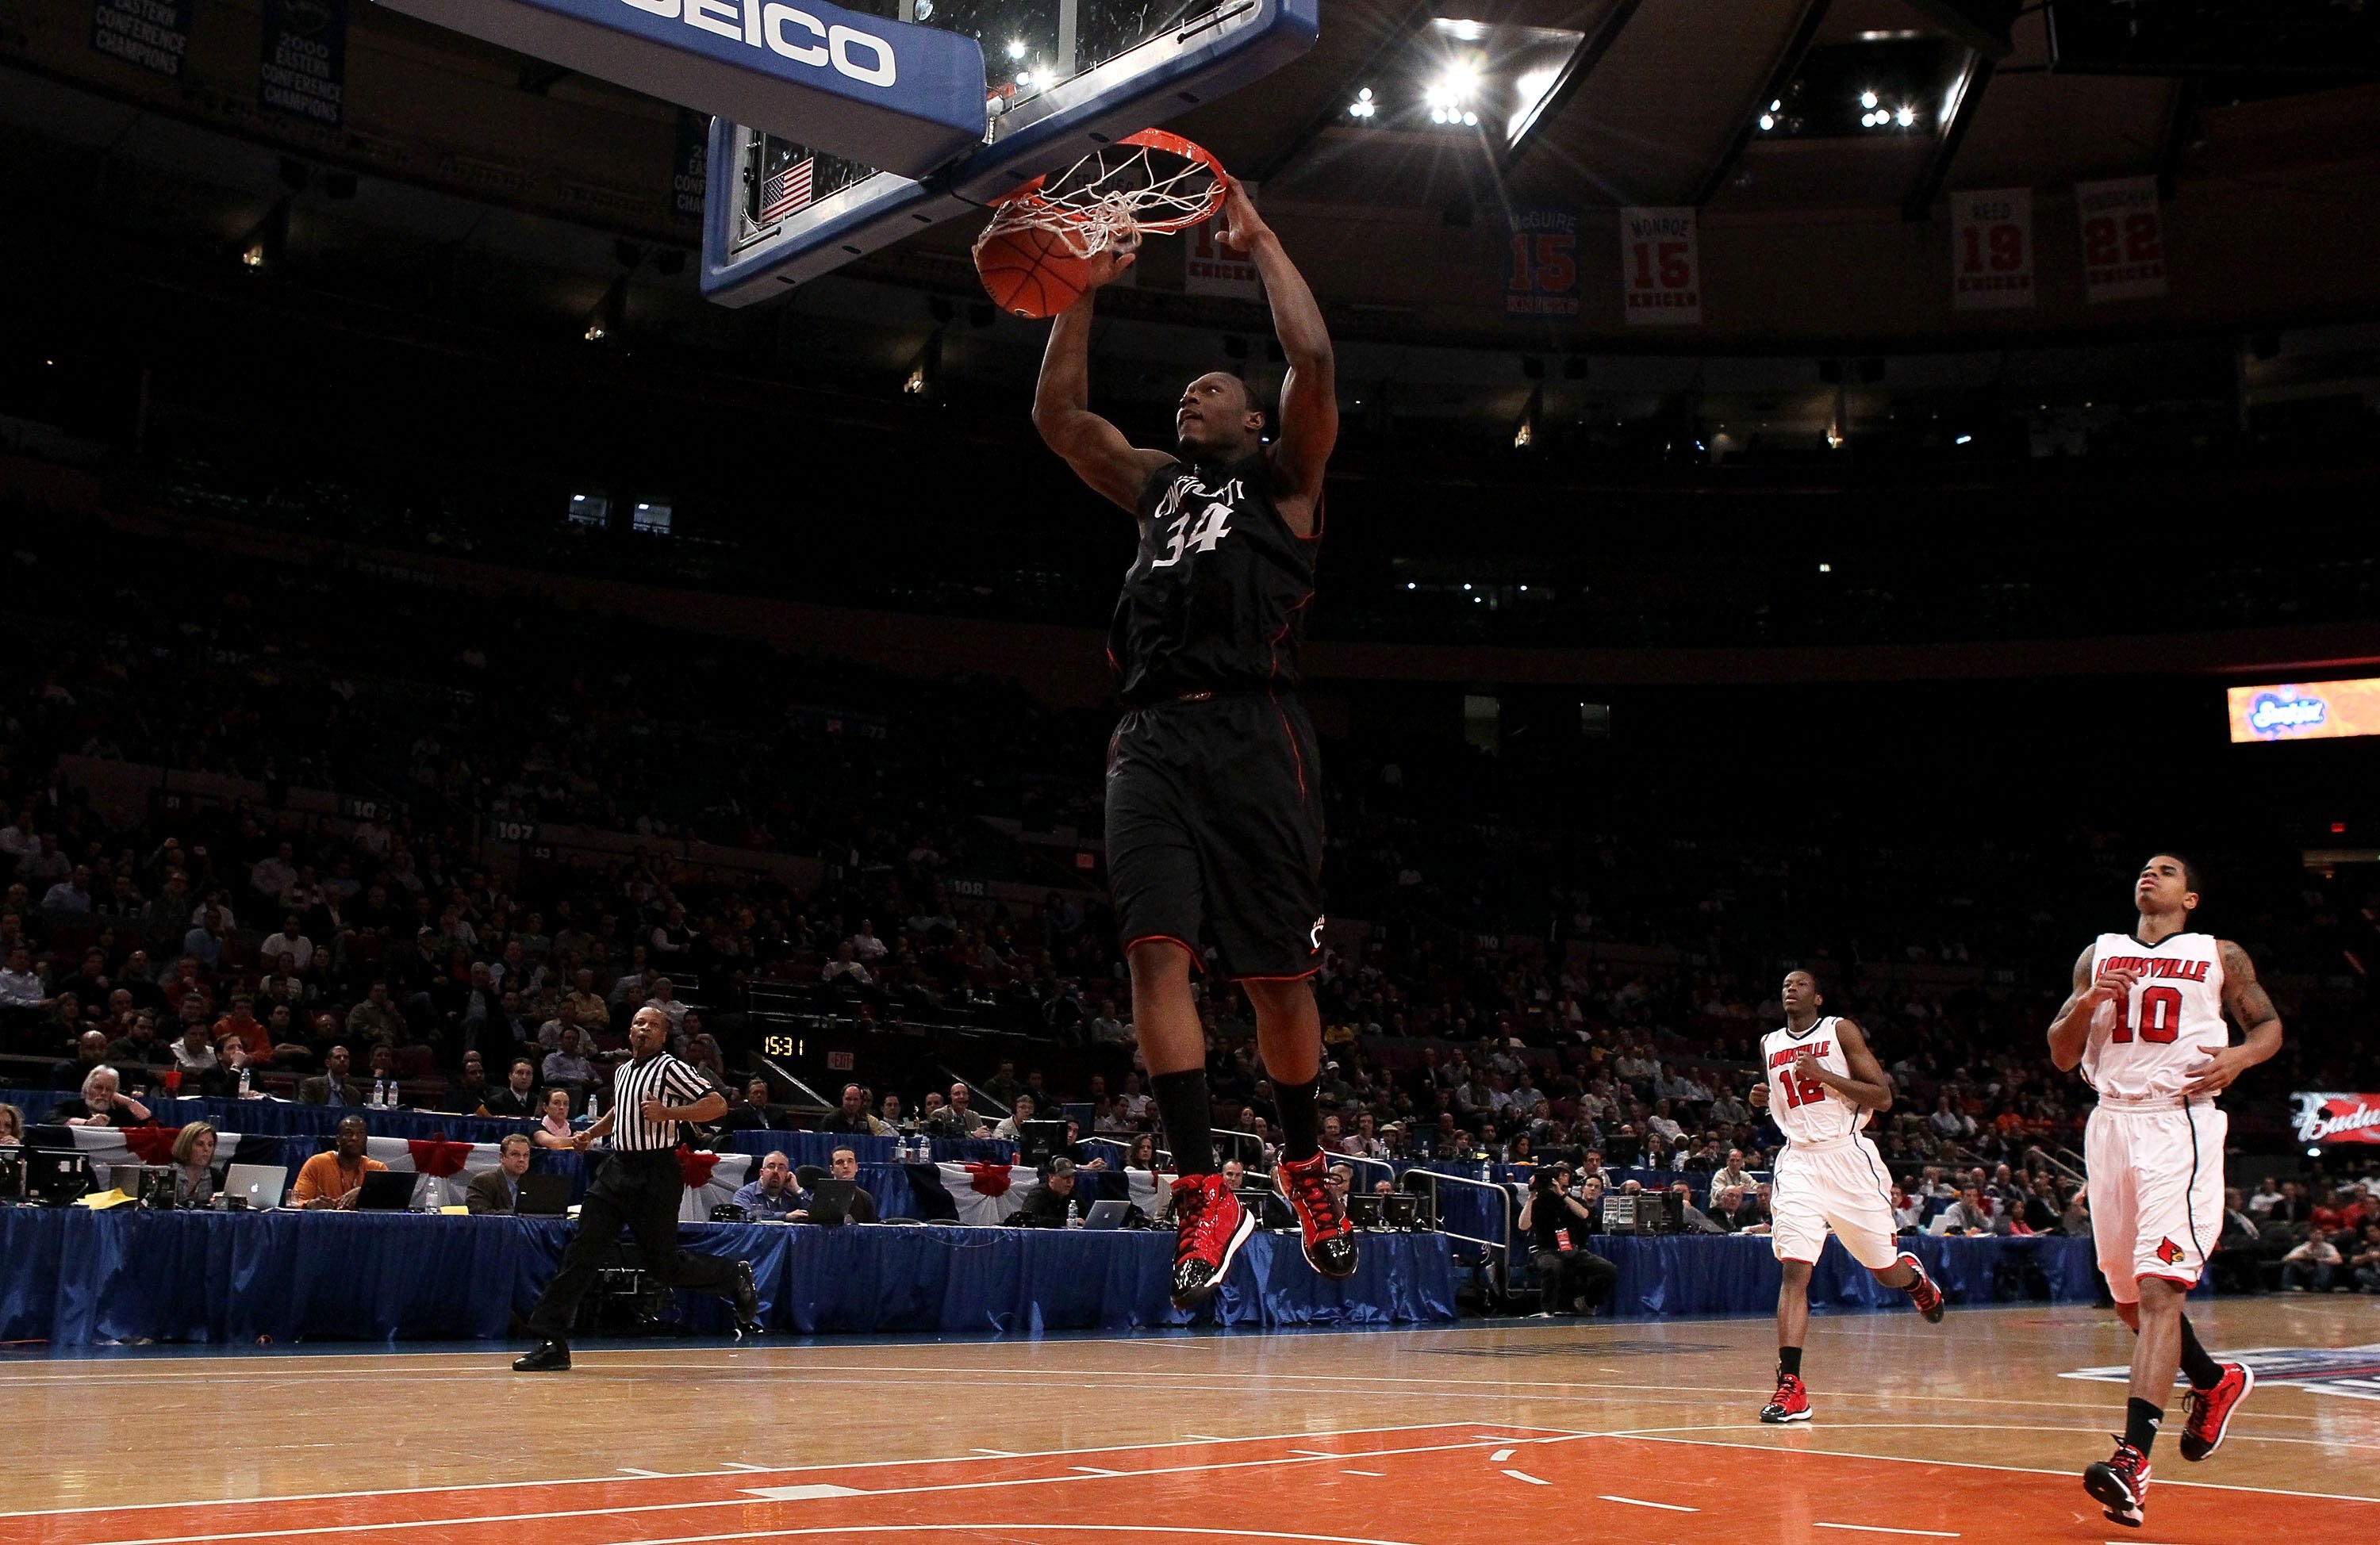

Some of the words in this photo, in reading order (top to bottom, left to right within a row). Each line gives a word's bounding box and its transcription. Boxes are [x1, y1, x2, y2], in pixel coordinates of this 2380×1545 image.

[95, 6, 186, 56] CONFERENCE
[279, 30, 328, 59] 2000
[96, 29, 178, 76] CHAMPIONS
[275, 46, 330, 79] EASTERN
[261, 63, 343, 103] CONFERENCE
[264, 83, 338, 123] CHAMPIONS
[1075, 174, 1134, 192] FRZIER
[1631, 217, 1690, 239] MONROE
[2084, 213, 2162, 266] 22
[1509, 233, 1576, 292] 15
[1633, 242, 1691, 289] 15
[1963, 224, 2022, 273] 19
[1507, 294, 1580, 315] KNICKS
[1629, 292, 1697, 307] KNICKS
[1150, 502, 1235, 571] 34
[499, 821, 534, 840] 107
[954, 880, 985, 895] 108
[2095, 956, 2211, 983] LOUISVILLE
[2112, 986, 2183, 1045] 10
[765, 1035, 804, 1056] 15:31
[834, 1052, 852, 1068] EXIT
[1779, 1069, 1825, 1110] 12
